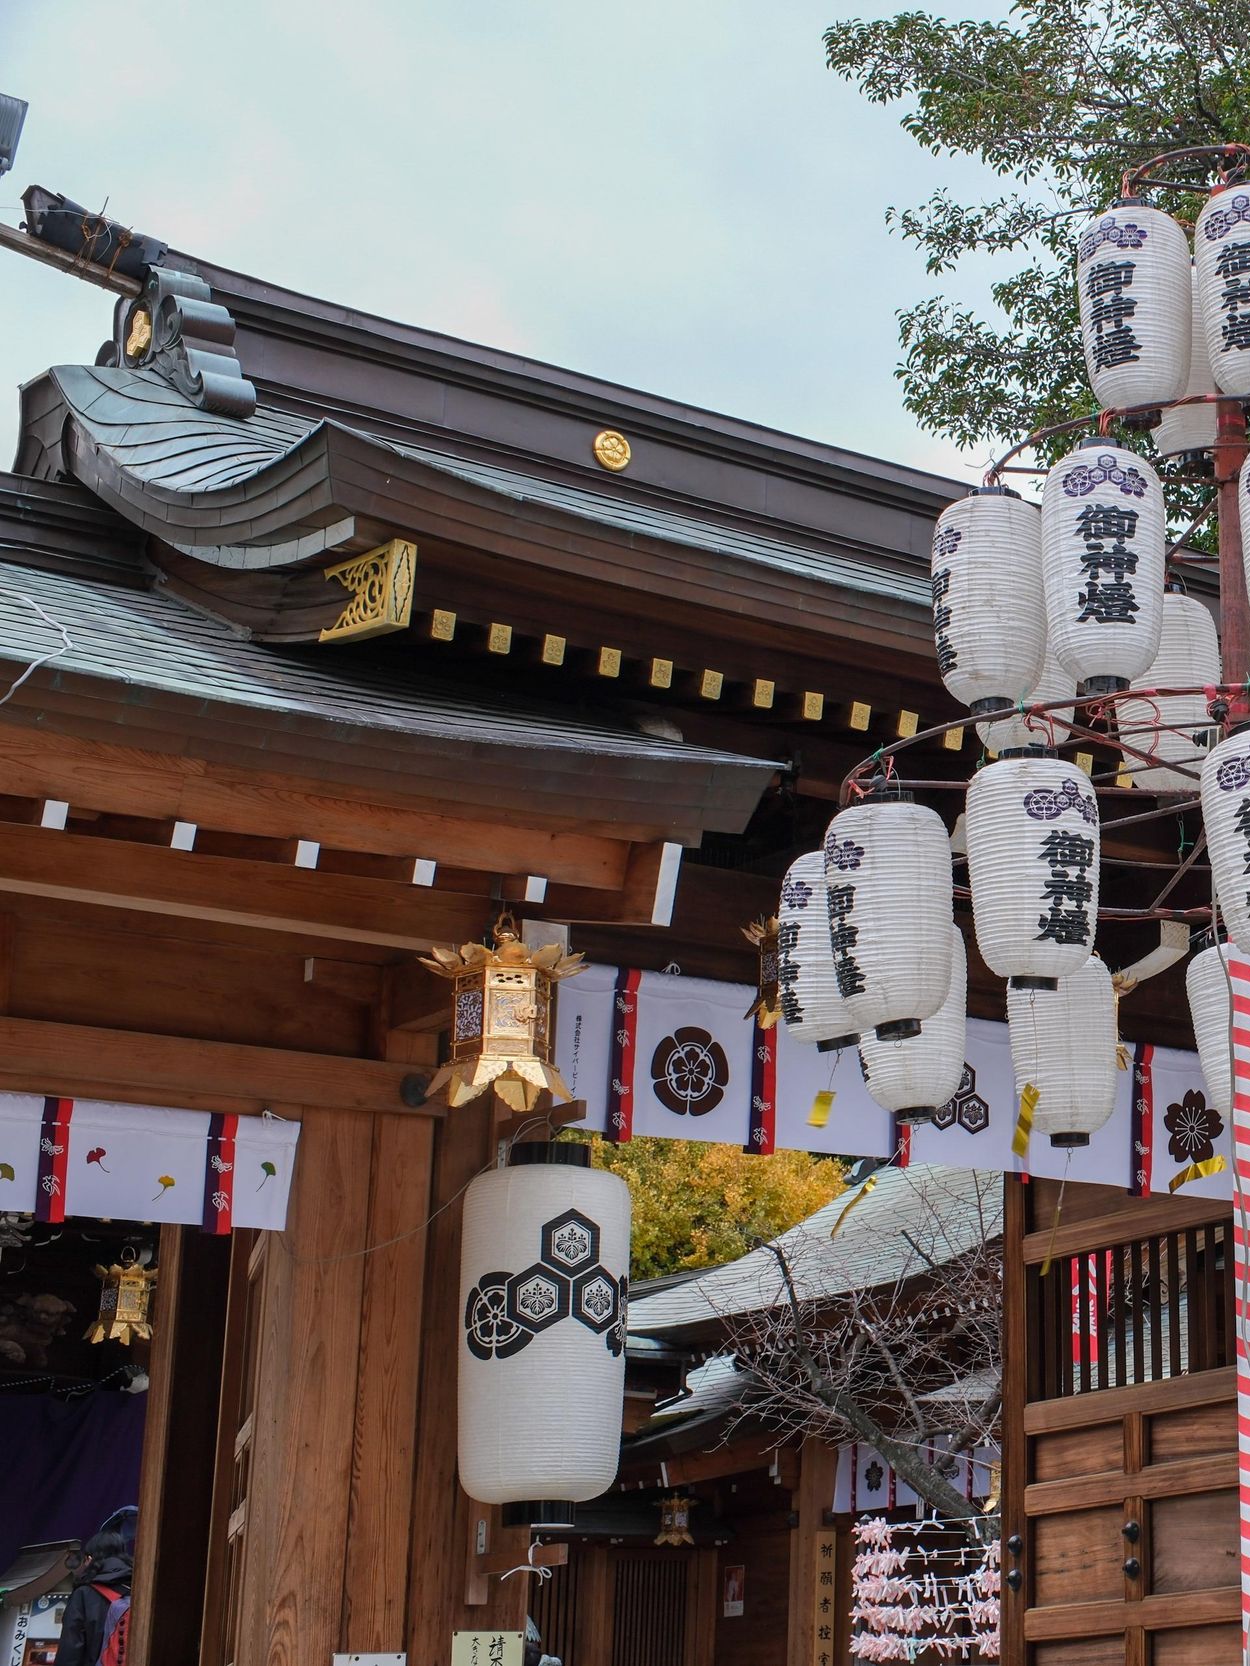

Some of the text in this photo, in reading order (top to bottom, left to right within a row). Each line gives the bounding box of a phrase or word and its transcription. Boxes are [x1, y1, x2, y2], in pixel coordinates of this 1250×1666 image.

[1086, 261, 1143, 374] 御神燈
[1075, 505, 1141, 625] 御神燈
[1032, 829, 1095, 947] 御神燈
[11, 1615, 28, 1666] おみくじ
[818, 1543, 833, 1666] 祈願者控室
